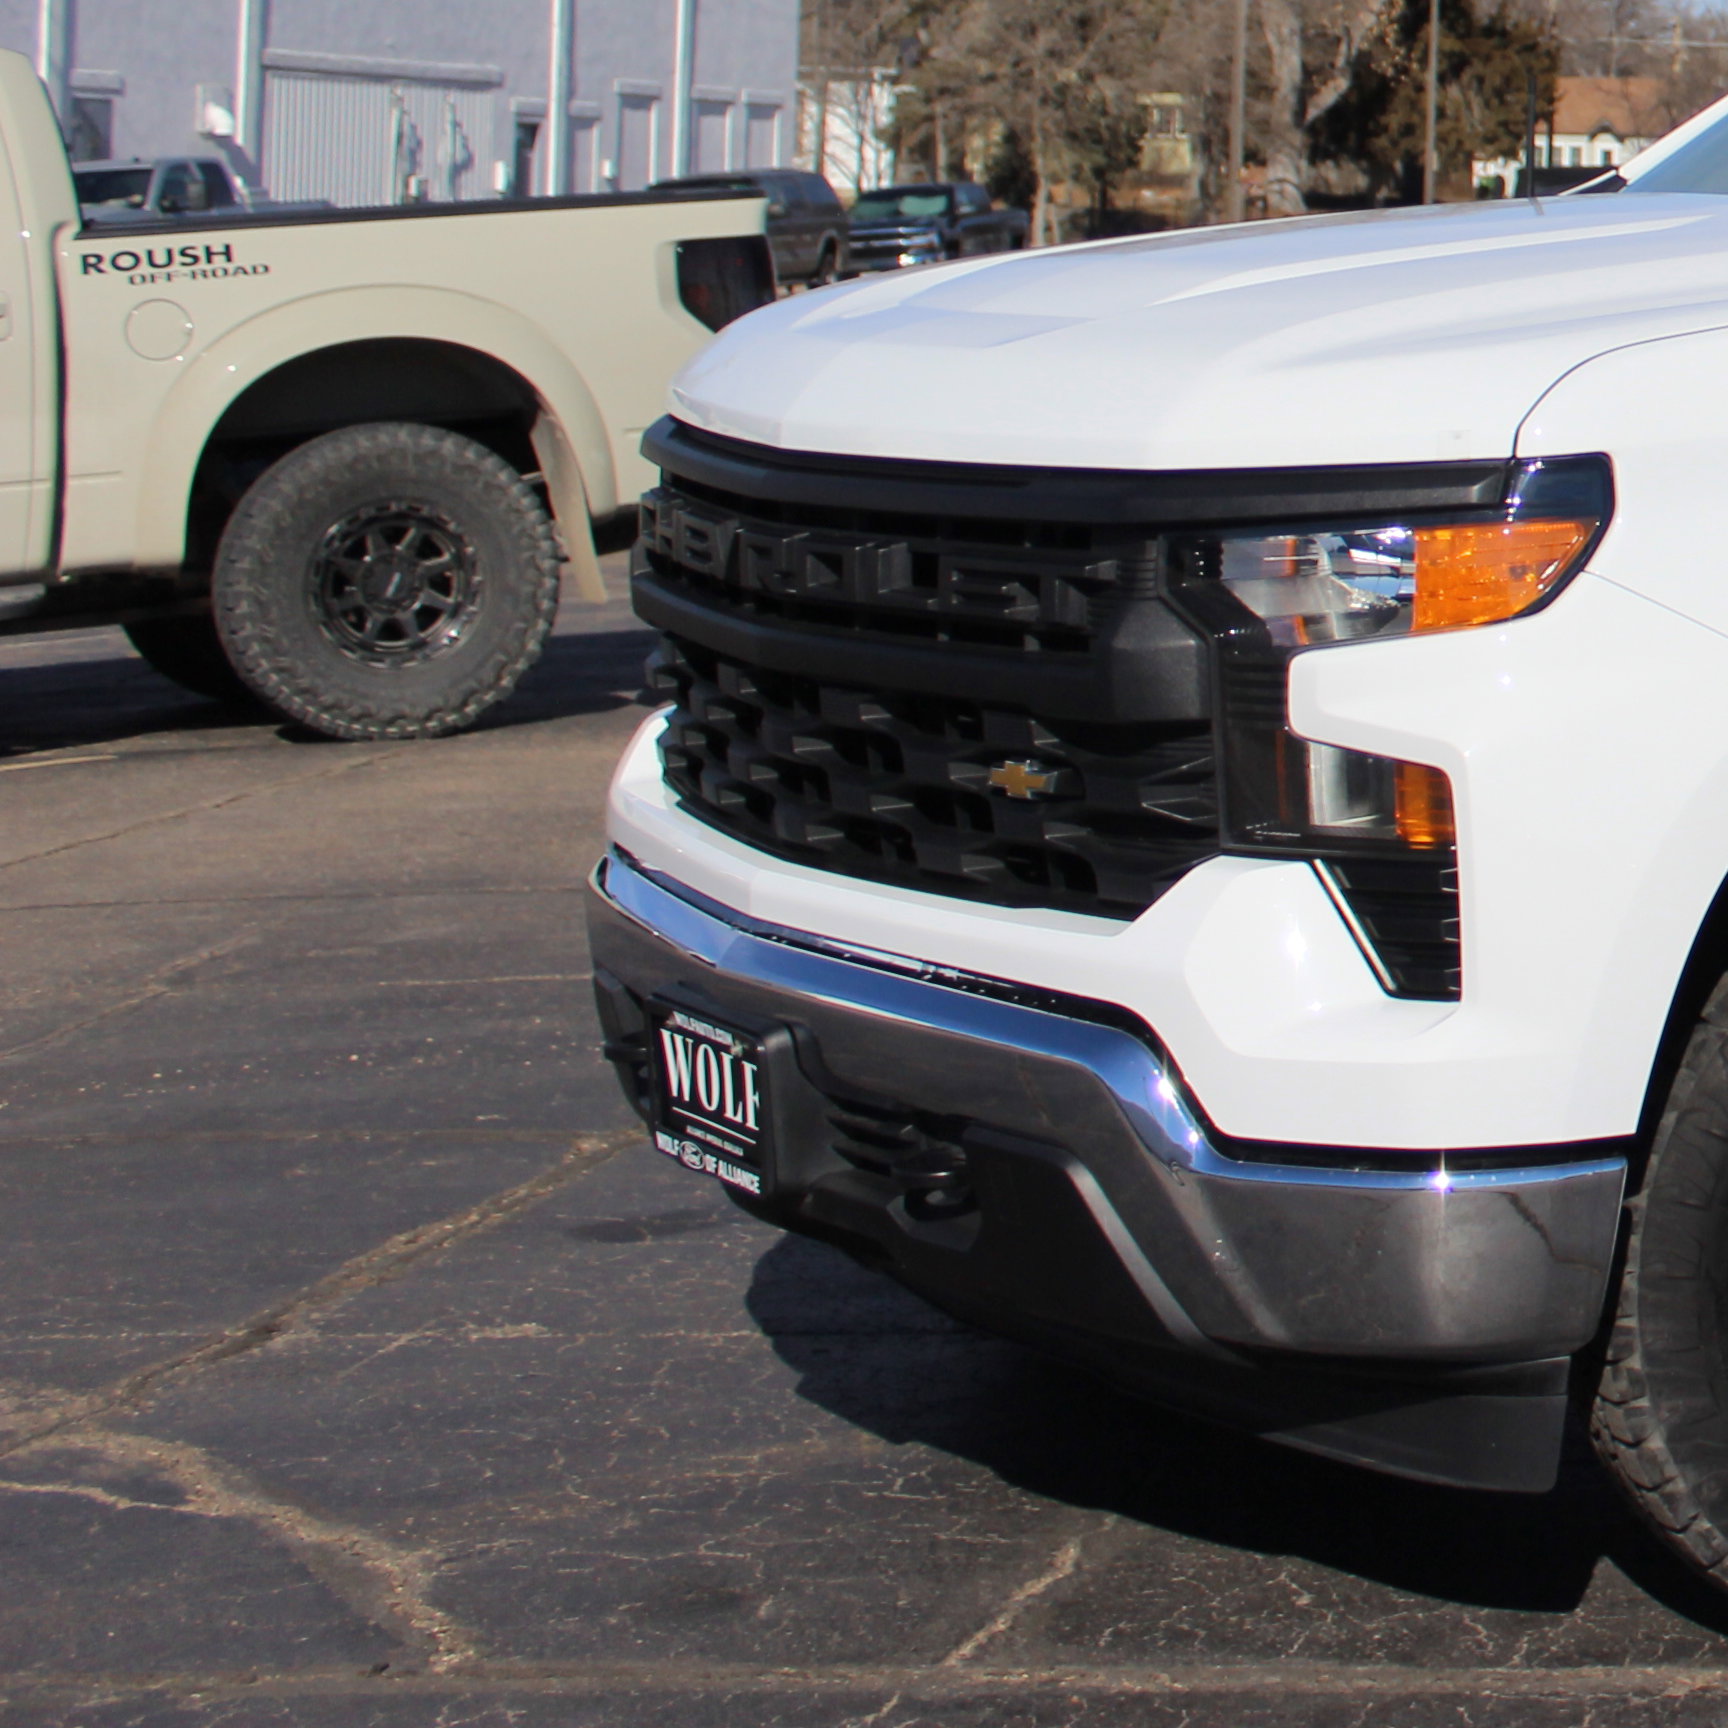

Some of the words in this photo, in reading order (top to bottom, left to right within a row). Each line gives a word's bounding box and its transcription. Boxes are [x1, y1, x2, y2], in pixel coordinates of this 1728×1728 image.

[80, 243, 234, 276] ROUSH
[128, 263, 271, 286] OFF-ROAD
[659, 1028, 760, 1131] WOLF
